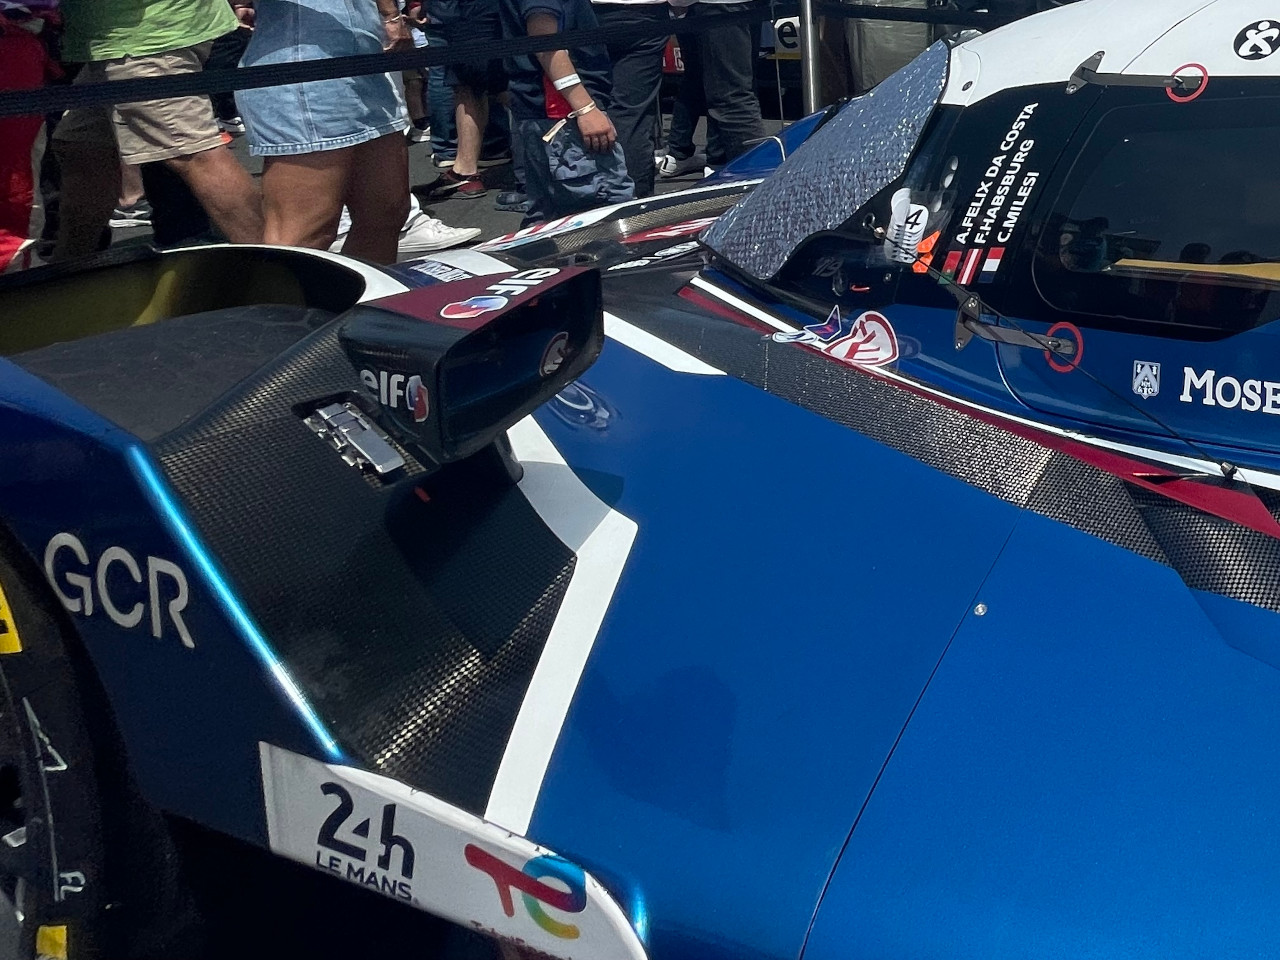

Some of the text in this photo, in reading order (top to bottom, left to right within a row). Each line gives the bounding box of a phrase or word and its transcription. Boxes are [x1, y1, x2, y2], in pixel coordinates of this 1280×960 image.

[955, 101, 1039, 245] A.FELIX DA COSTA
[973, 138, 1035, 245] F.HABSBURG
[997, 171, 1040, 244] C.MILESI
[485, 268, 561, 296] elf
[359, 369, 405, 408] elf
[43, 532, 196, 649] GCR
[317, 781, 416, 881] 24h
[315, 850, 413, 904] LE MANS
